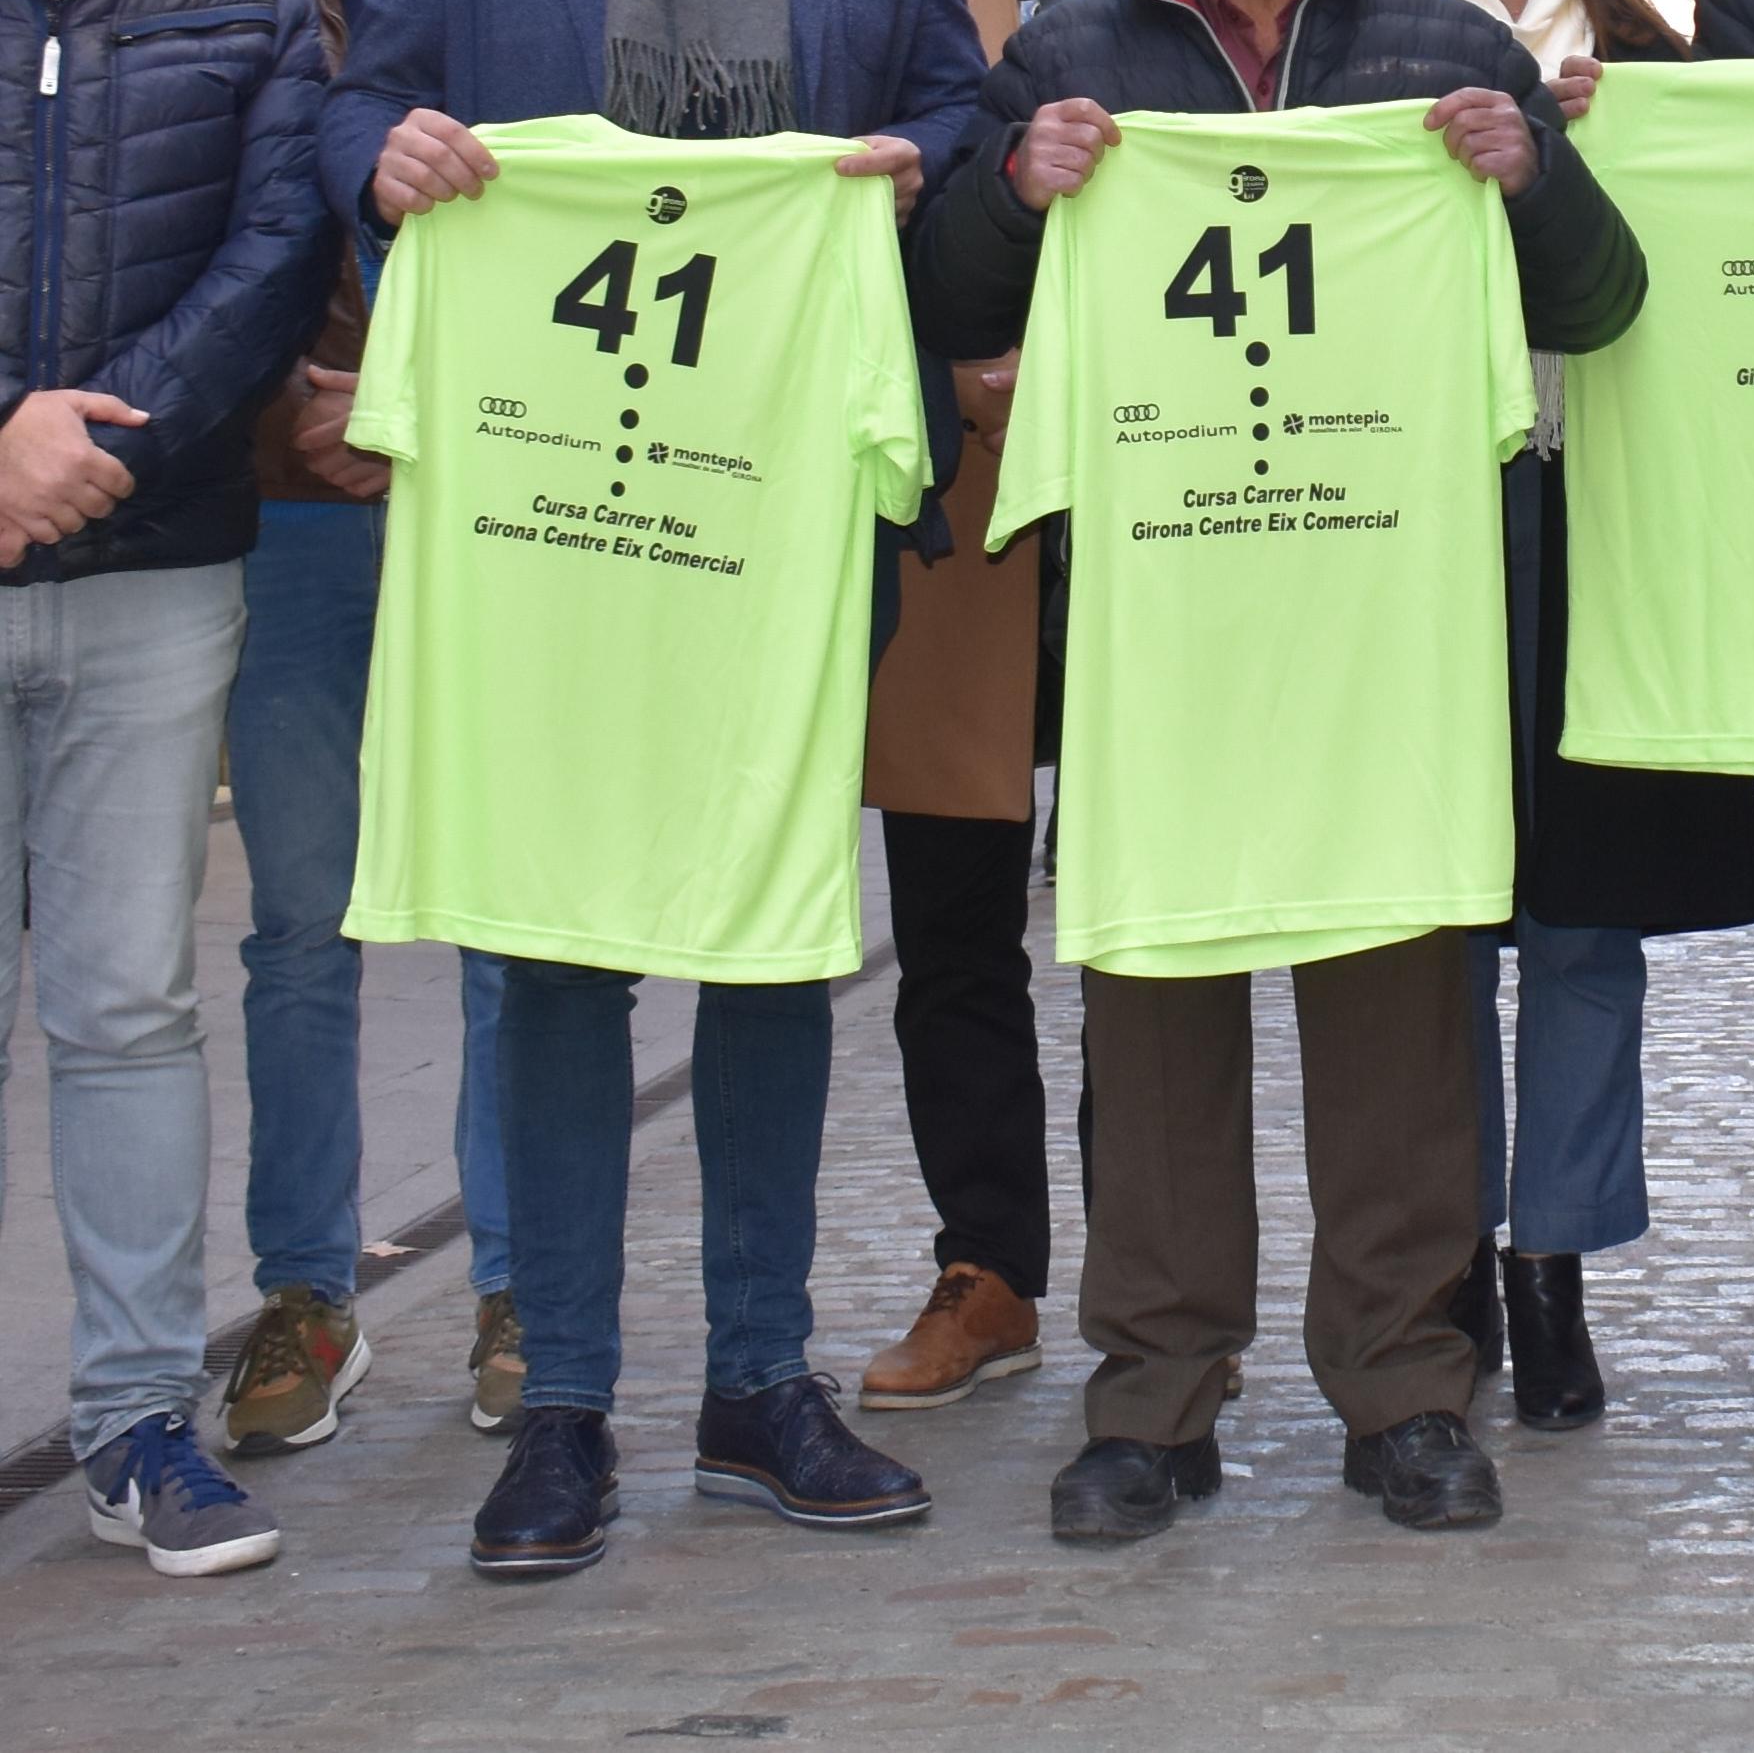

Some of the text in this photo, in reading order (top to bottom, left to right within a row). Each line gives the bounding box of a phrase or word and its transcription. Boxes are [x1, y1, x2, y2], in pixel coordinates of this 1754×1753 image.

[1164, 223, 1315, 337] 41
[552, 239, 717, 368] 41
[1116, 423, 1237, 444] Autopodium
[1308, 410, 1390, 428] montepio
[476, 420, 601, 452] Autopodium
[673, 448, 753, 472] montepio
[1183, 483, 1346, 509] Cursa Carrer Nou
[532, 494, 698, 539] Cursa Carrer Nou
[1132, 509, 1399, 541] Girona Centre Eix Comercial
[474, 515, 745, 577] Girona Centre Eix Comercial
